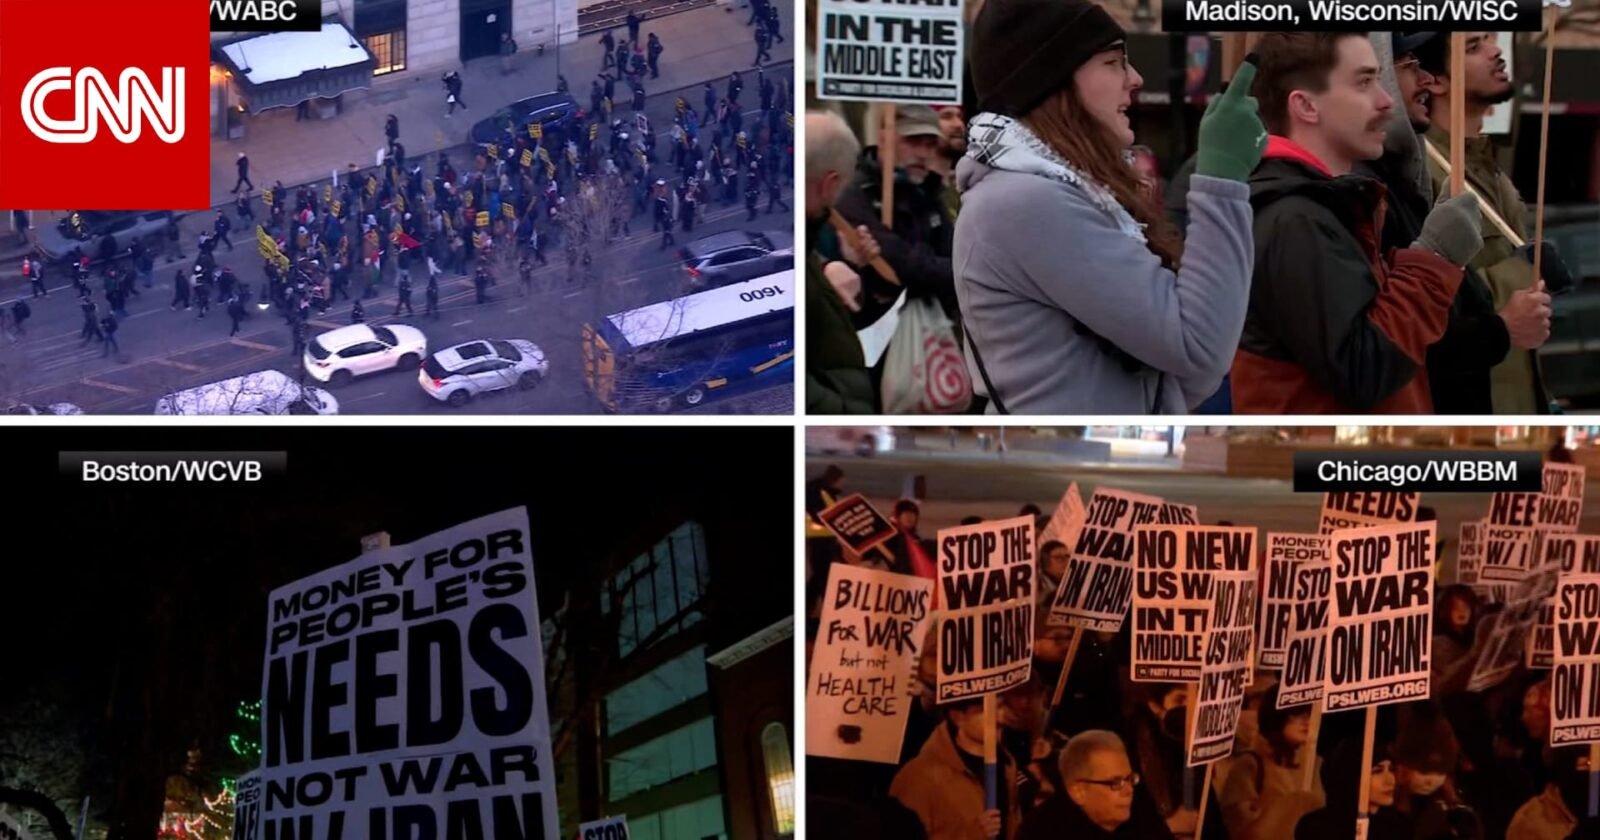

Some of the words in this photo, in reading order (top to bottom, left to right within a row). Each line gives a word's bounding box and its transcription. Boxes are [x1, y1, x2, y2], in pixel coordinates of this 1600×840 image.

[826, 13, 870, 41] IN
[875, 16, 957, 46] THE
[825, 43, 902, 77] MIDDLE
[908, 48, 957, 80] EAST
[739, 285, 785, 303] 1600
[1538, 497, 1580, 526] WAR
[942, 530, 996, 573] STOP
[1001, 524, 1032, 564] THE
[1138, 530, 1177, 570] NO
[1186, 531, 1252, 571] NEW
[1272, 536, 1325, 548] MONEY
[1489, 530, 1523, 540] NOT
[1336, 535, 1391, 579] STOP
[1396, 529, 1431, 571] THE
[273, 558, 416, 622] MONEY
[424, 529, 524, 580] FOR
[942, 563, 1032, 611] WAR
[1137, 571, 1178, 600] US
[1335, 570, 1429, 617] WAR
[270, 561, 527, 655] PEOPLE'S
[1137, 607, 1174, 632] IN
[1213, 580, 1235, 629] NO
[827, 620, 859, 645] FOR
[864, 616, 917, 656] WAR
[942, 615, 974, 676] ON
[981, 603, 1032, 671] IRAN!
[1136, 634, 1202, 662] MIDDLE
[1205, 631, 1228, 666] US
[1331, 623, 1364, 686] ON
[1368, 613, 1429, 680] IRAN!
[839, 648, 863, 668] but
[866, 655, 889, 670] not
[1150, 667, 1168, 677] PARTY
[1285, 636, 1315, 688] ON
[265, 603, 534, 768] NEEDS
[816, 672, 896, 697] HEALTH
[1201, 672, 1221, 702] IN
[1221, 667, 1245, 699] THE
[1328, 680, 1427, 708] PSLWEB.ORG
[1555, 662, 1585, 721] ON
[842, 697, 897, 716] CARE
[265, 766, 367, 812] NOT
[379, 745, 541, 798] WAR
